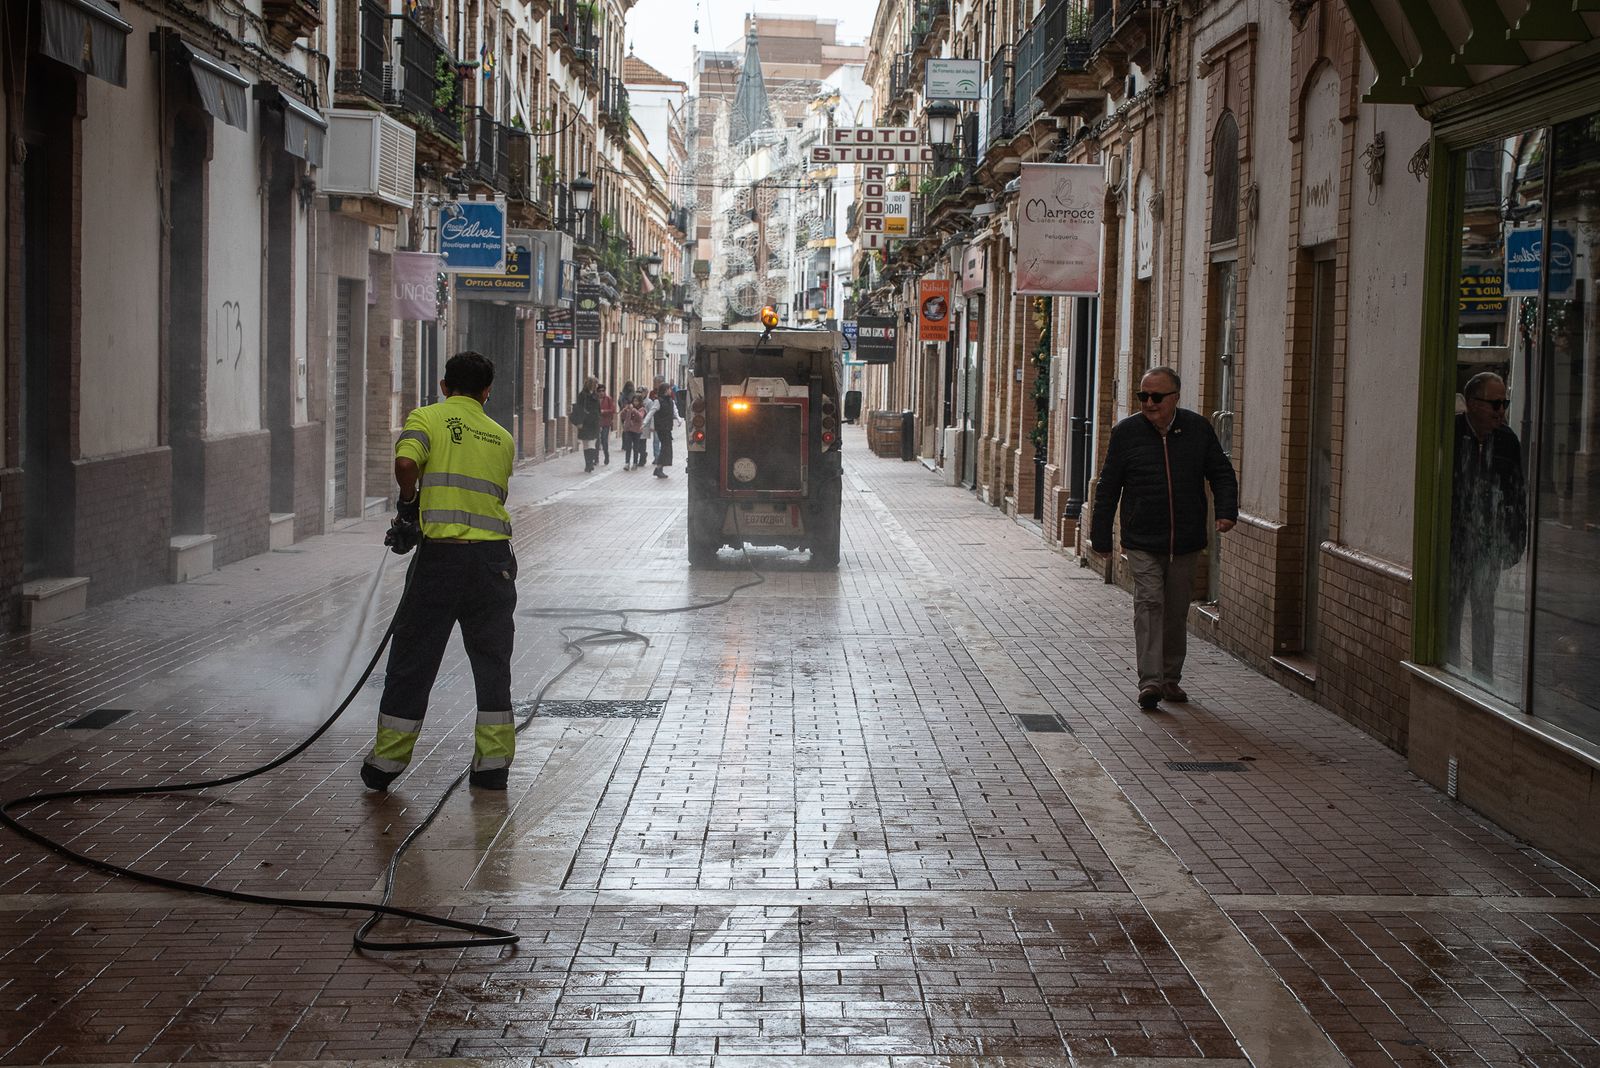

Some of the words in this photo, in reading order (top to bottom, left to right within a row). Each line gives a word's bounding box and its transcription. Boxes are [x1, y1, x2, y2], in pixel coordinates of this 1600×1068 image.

[835, 129, 917, 142] FOTO
[865, 167, 884, 248] RODRI
[442, 241, 470, 249] Boutique
[483, 242, 501, 250] Tejido
[394, 282, 435, 302] UÑAS
[860, 328, 871, 336] LA
[463, 424, 501, 441] Ayuntamiento
[482, 436, 501, 446] Huelva
